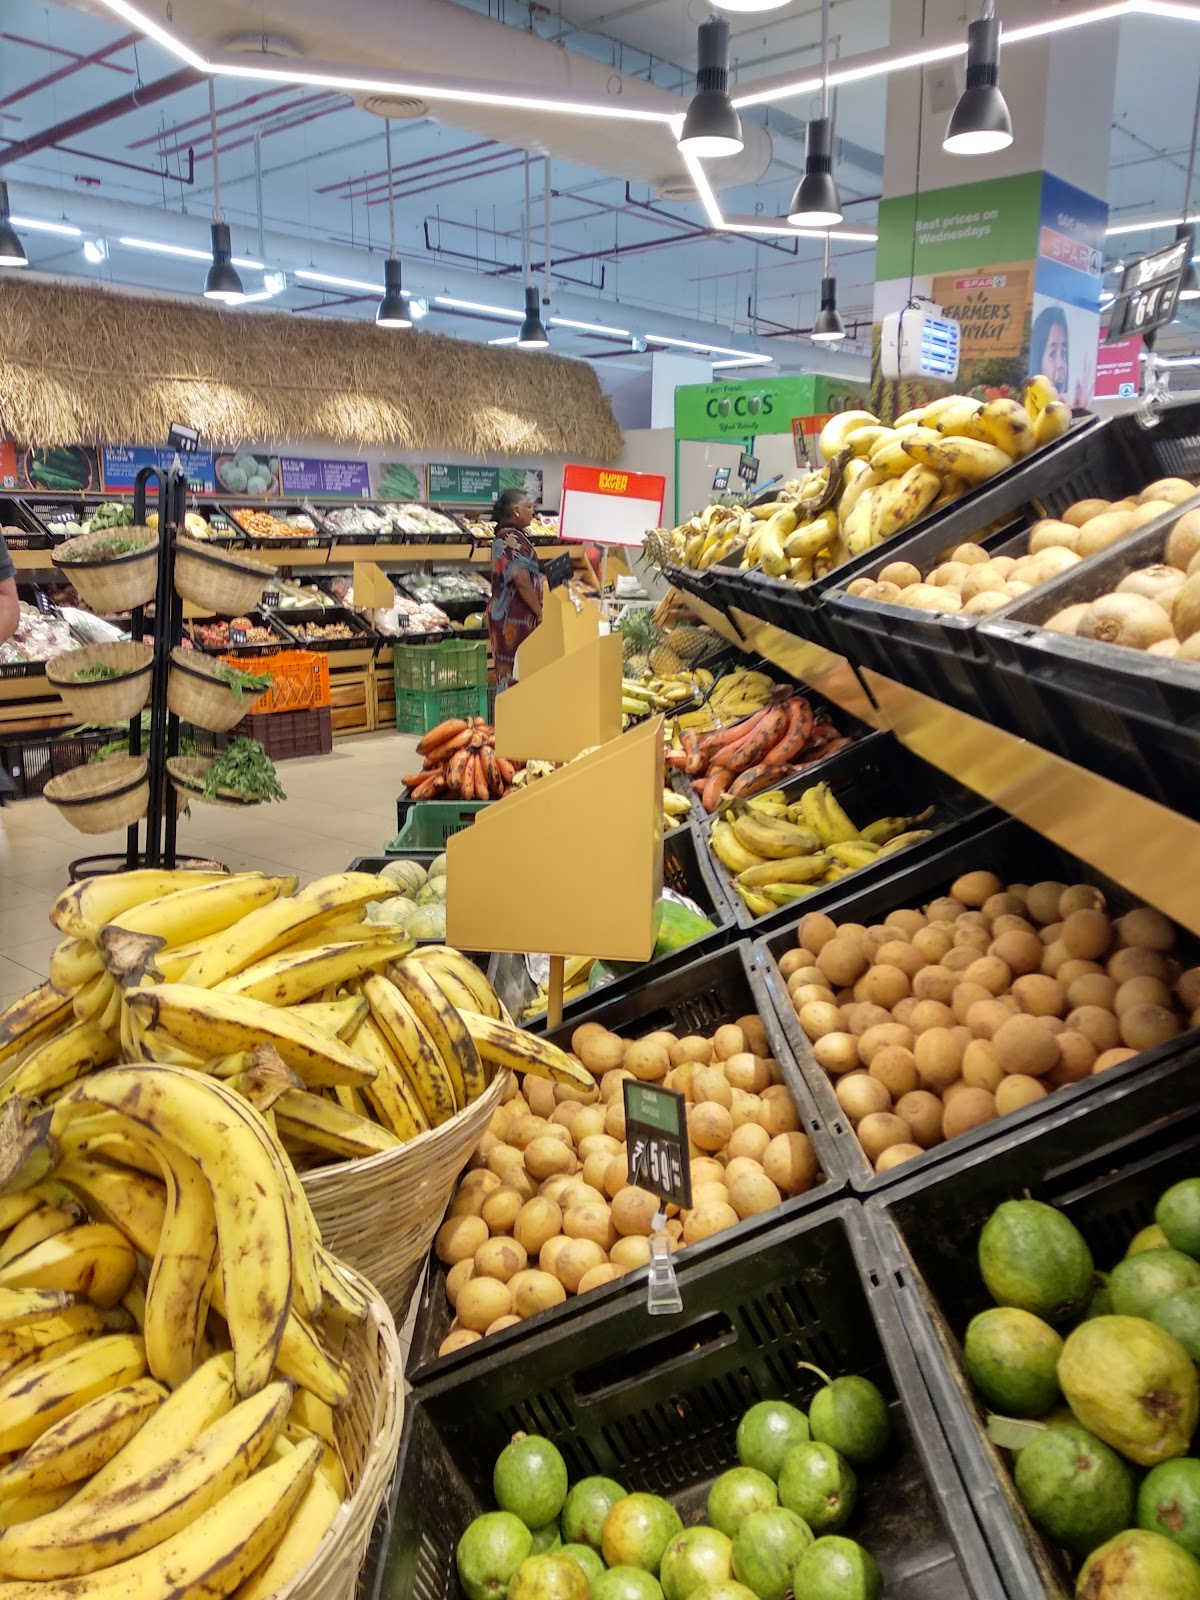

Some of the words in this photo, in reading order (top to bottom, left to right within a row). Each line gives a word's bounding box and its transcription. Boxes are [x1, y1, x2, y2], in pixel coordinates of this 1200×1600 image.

[914, 217, 940, 232] Best
[942, 213, 980, 229] prices
[982, 209, 999, 220] on
[920, 225, 992, 245] Wednesdays
[1052, 239, 1089, 269] SPAR
[963, 278, 993, 288] SPAR
[705, 386, 723, 394] Farm
[724, 384, 743, 392] Fresh
[706, 394, 774, 419] COCOS
[598, 480, 628, 491] SAVER
[599, 471, 628, 484] SUPER
